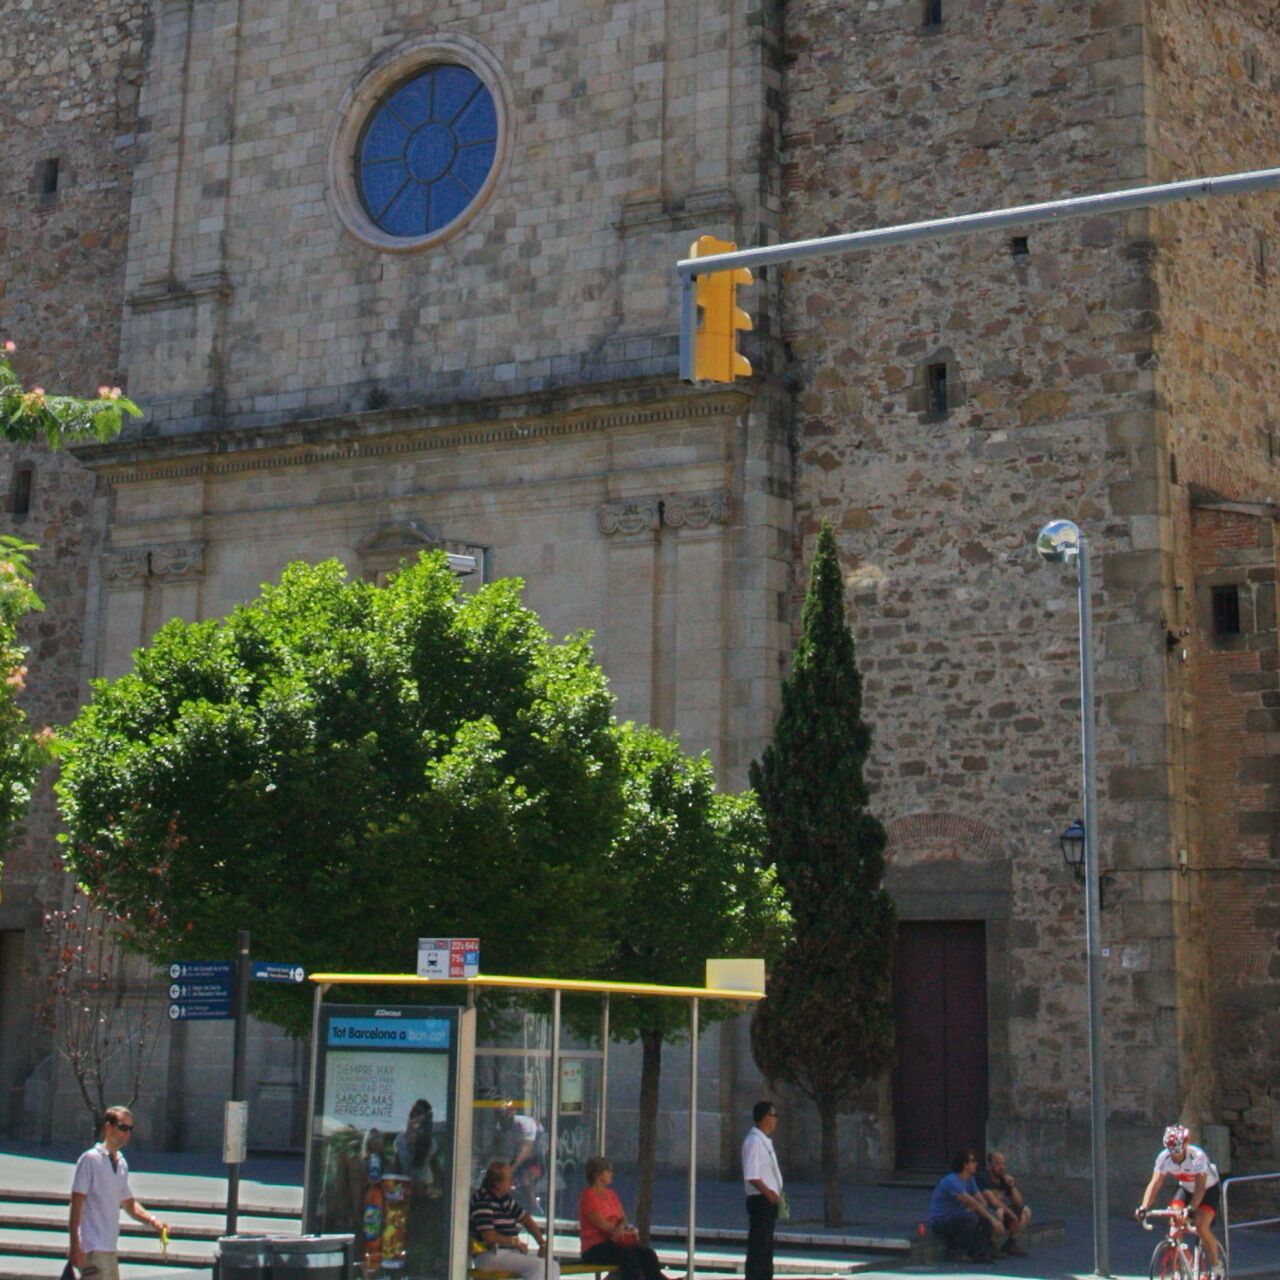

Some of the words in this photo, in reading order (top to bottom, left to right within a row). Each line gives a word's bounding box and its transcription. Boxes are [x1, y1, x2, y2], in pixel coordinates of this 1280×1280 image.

[332, 1026, 347, 1039] Tot
[348, 1027, 397, 1040] Barcelona
[400, 1030, 407, 1040] a
[335, 1093, 369, 1105] SABOR
[335, 1104, 393, 1118] REFRESCANTE
